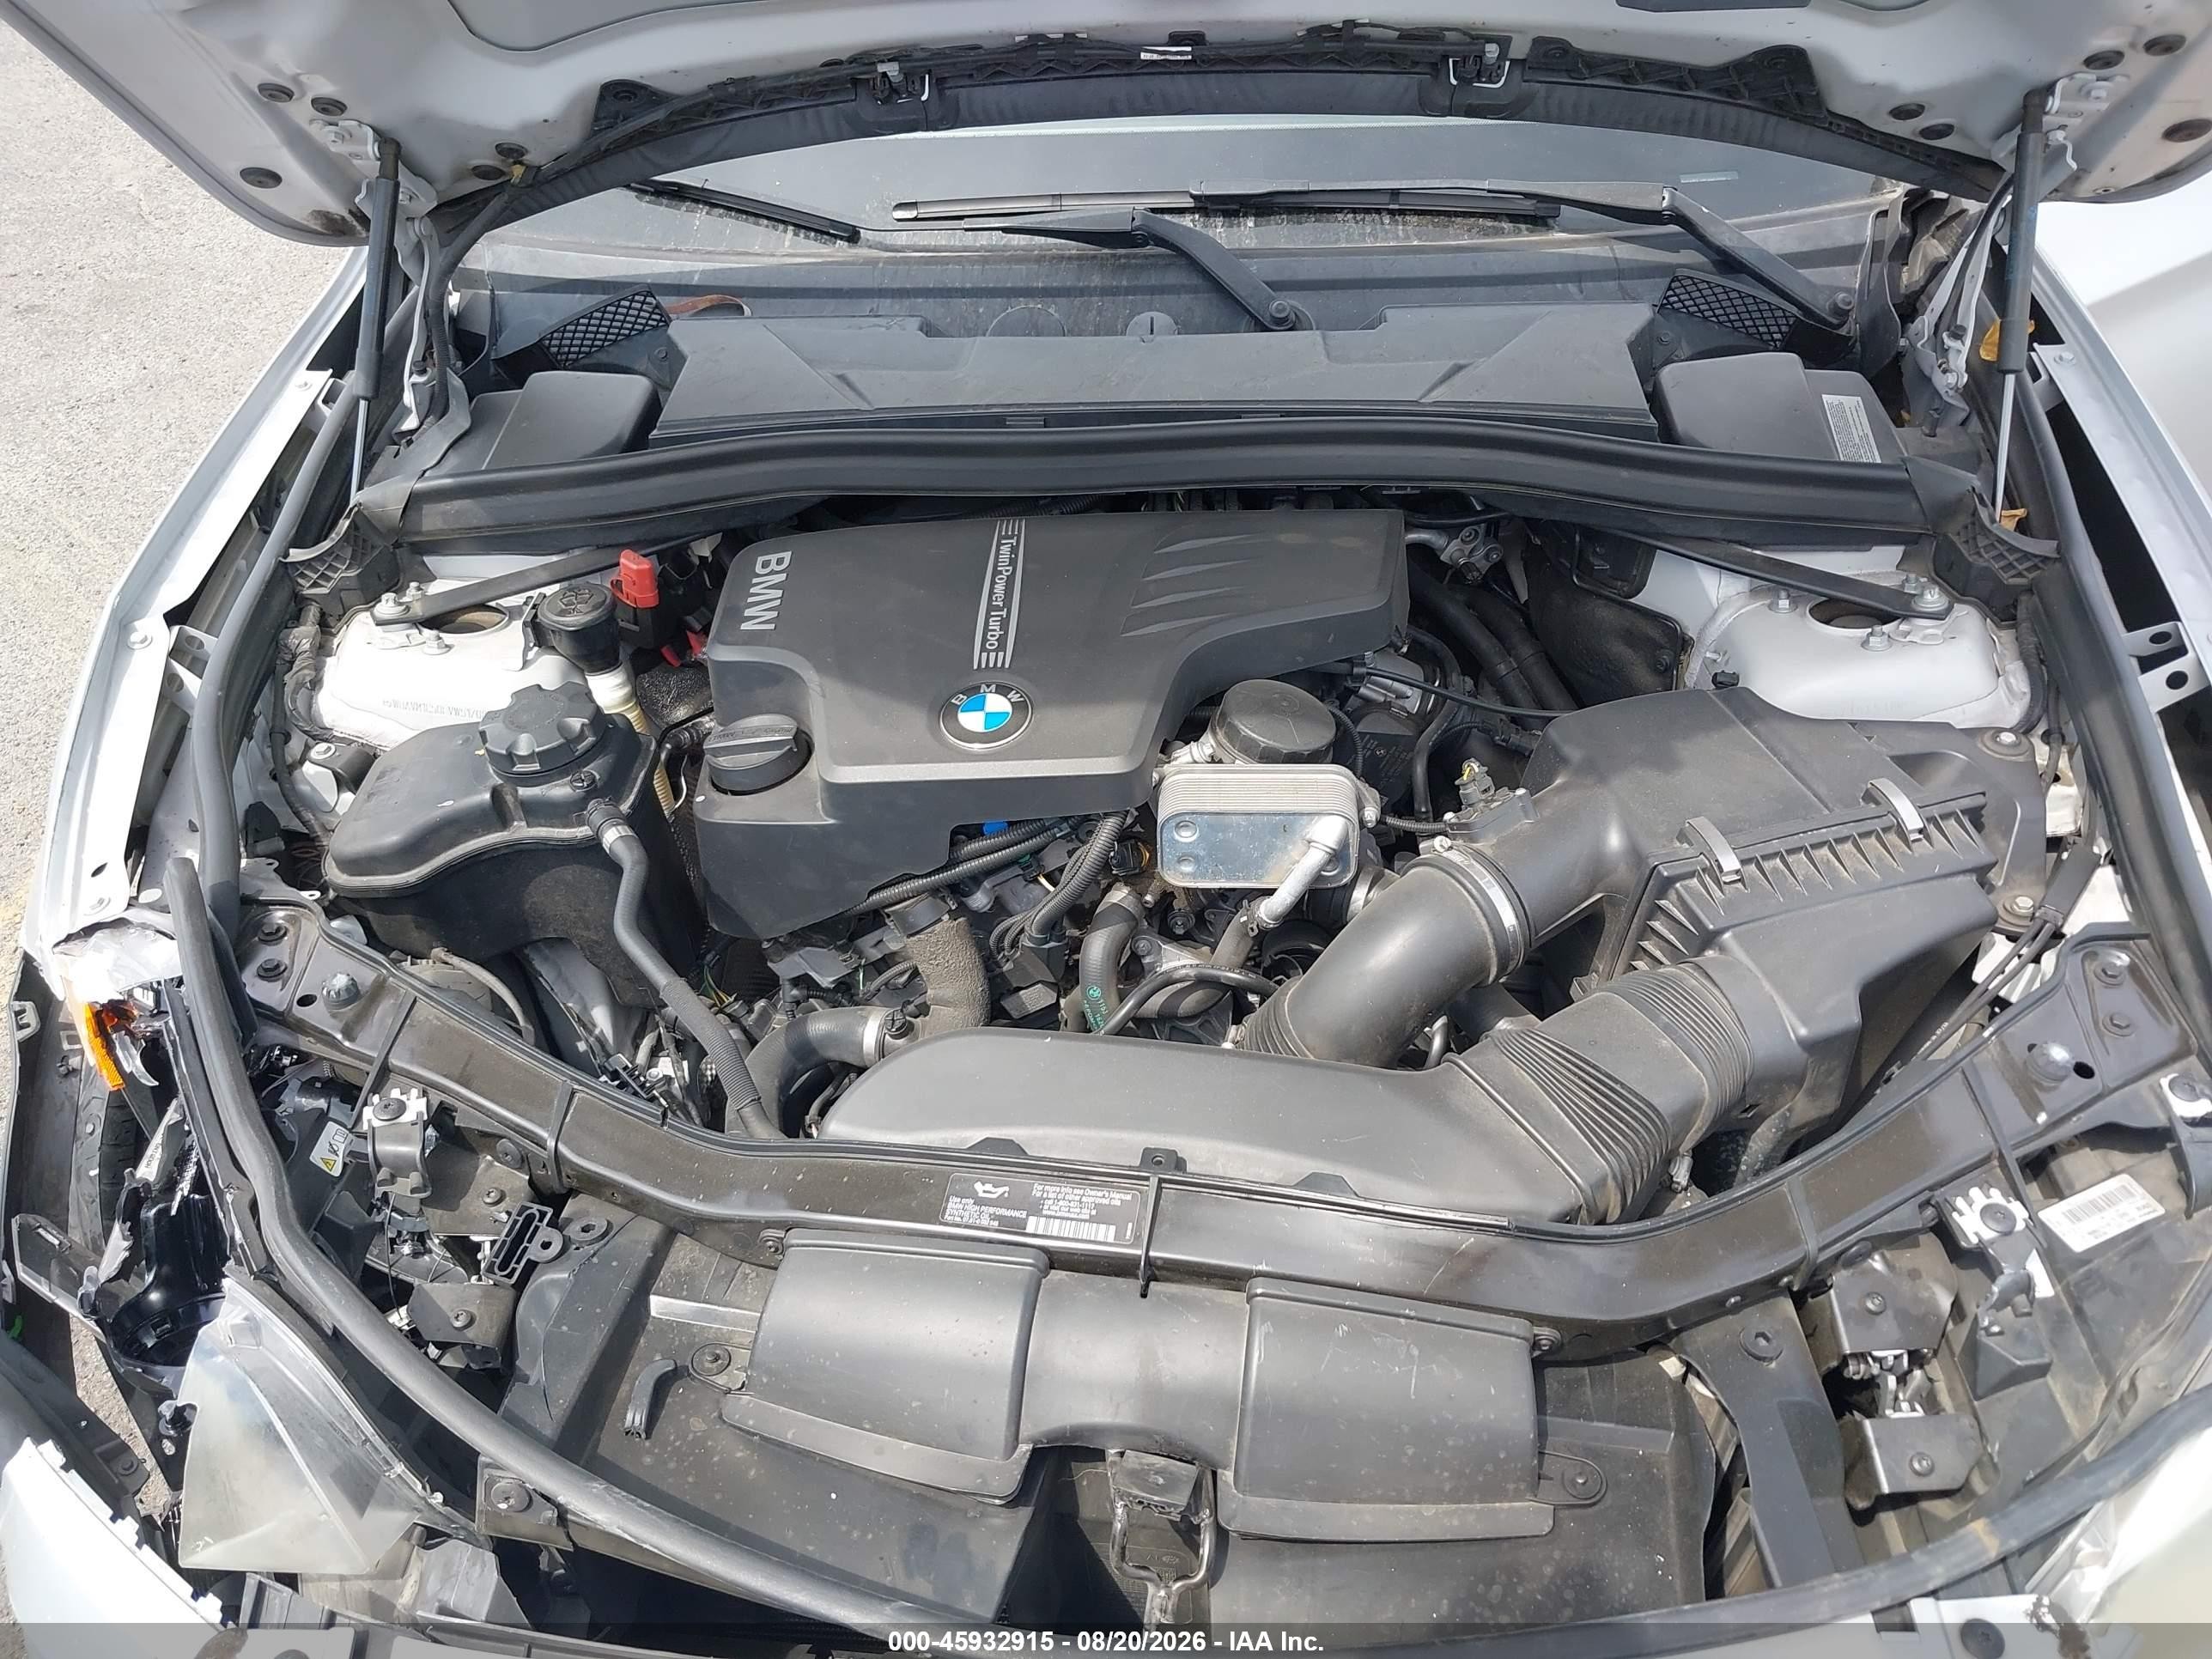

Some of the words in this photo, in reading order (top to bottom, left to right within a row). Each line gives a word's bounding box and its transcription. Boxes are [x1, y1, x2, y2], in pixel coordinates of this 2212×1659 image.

[992, 536, 1018, 608] TwinPower
[740, 550, 793, 631] BMW
[985, 608, 1008, 650] Turbo
[952, 684, 1025, 707] BMW
[1085, 1188, 1109, 1198] Owner's
[1109, 1190, 1133, 1200] Manual
[945, 1208, 980, 1219] SYNTHETIC
[947, 1201, 963, 1210] BMW
[963, 1204, 980, 1212] HIGH
[980, 1206, 1027, 1218] PERFORMANCE
